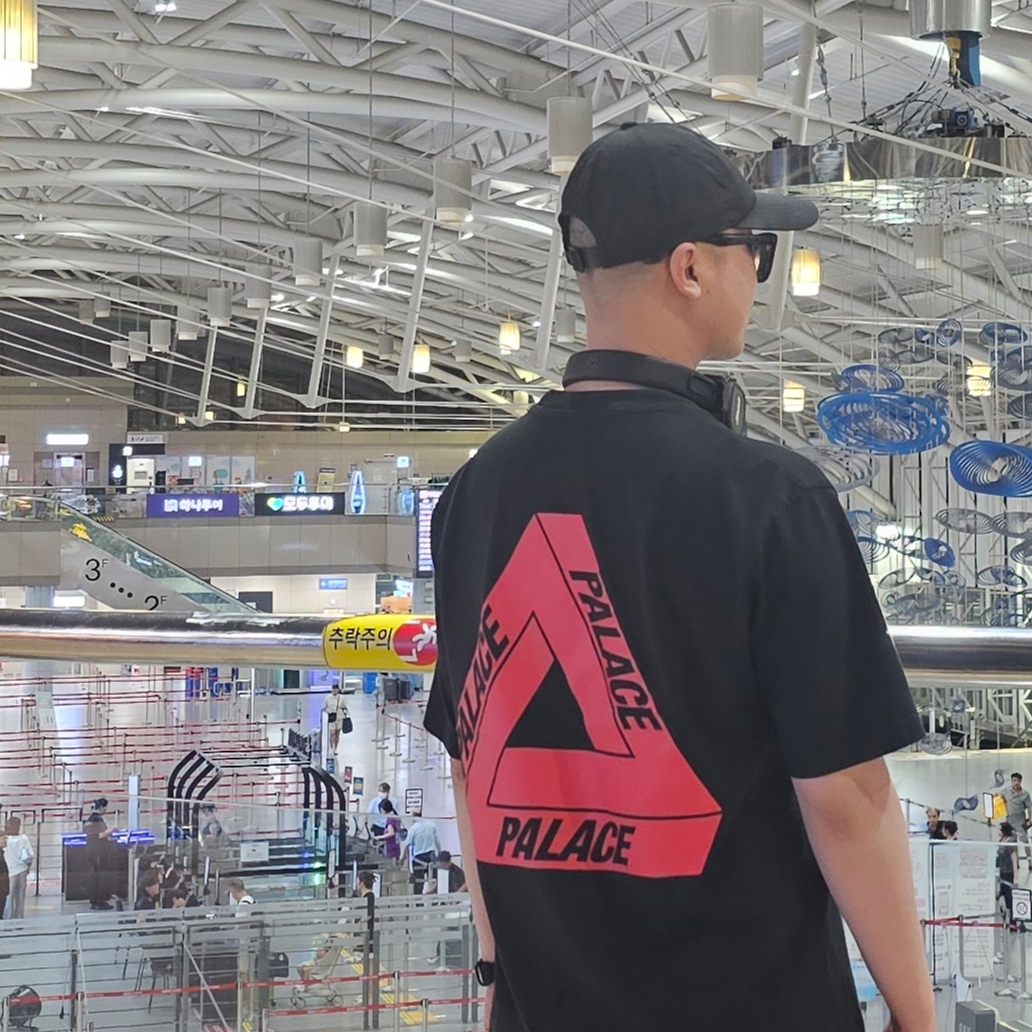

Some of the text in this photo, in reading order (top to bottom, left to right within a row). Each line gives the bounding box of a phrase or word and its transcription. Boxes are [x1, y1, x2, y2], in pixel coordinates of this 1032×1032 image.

[85, 558, 109, 581] 3F
[328, 626, 393, 651] 추락주의
[568, 569, 663, 732] PALACE
[495, 816, 636, 867] PALACE
